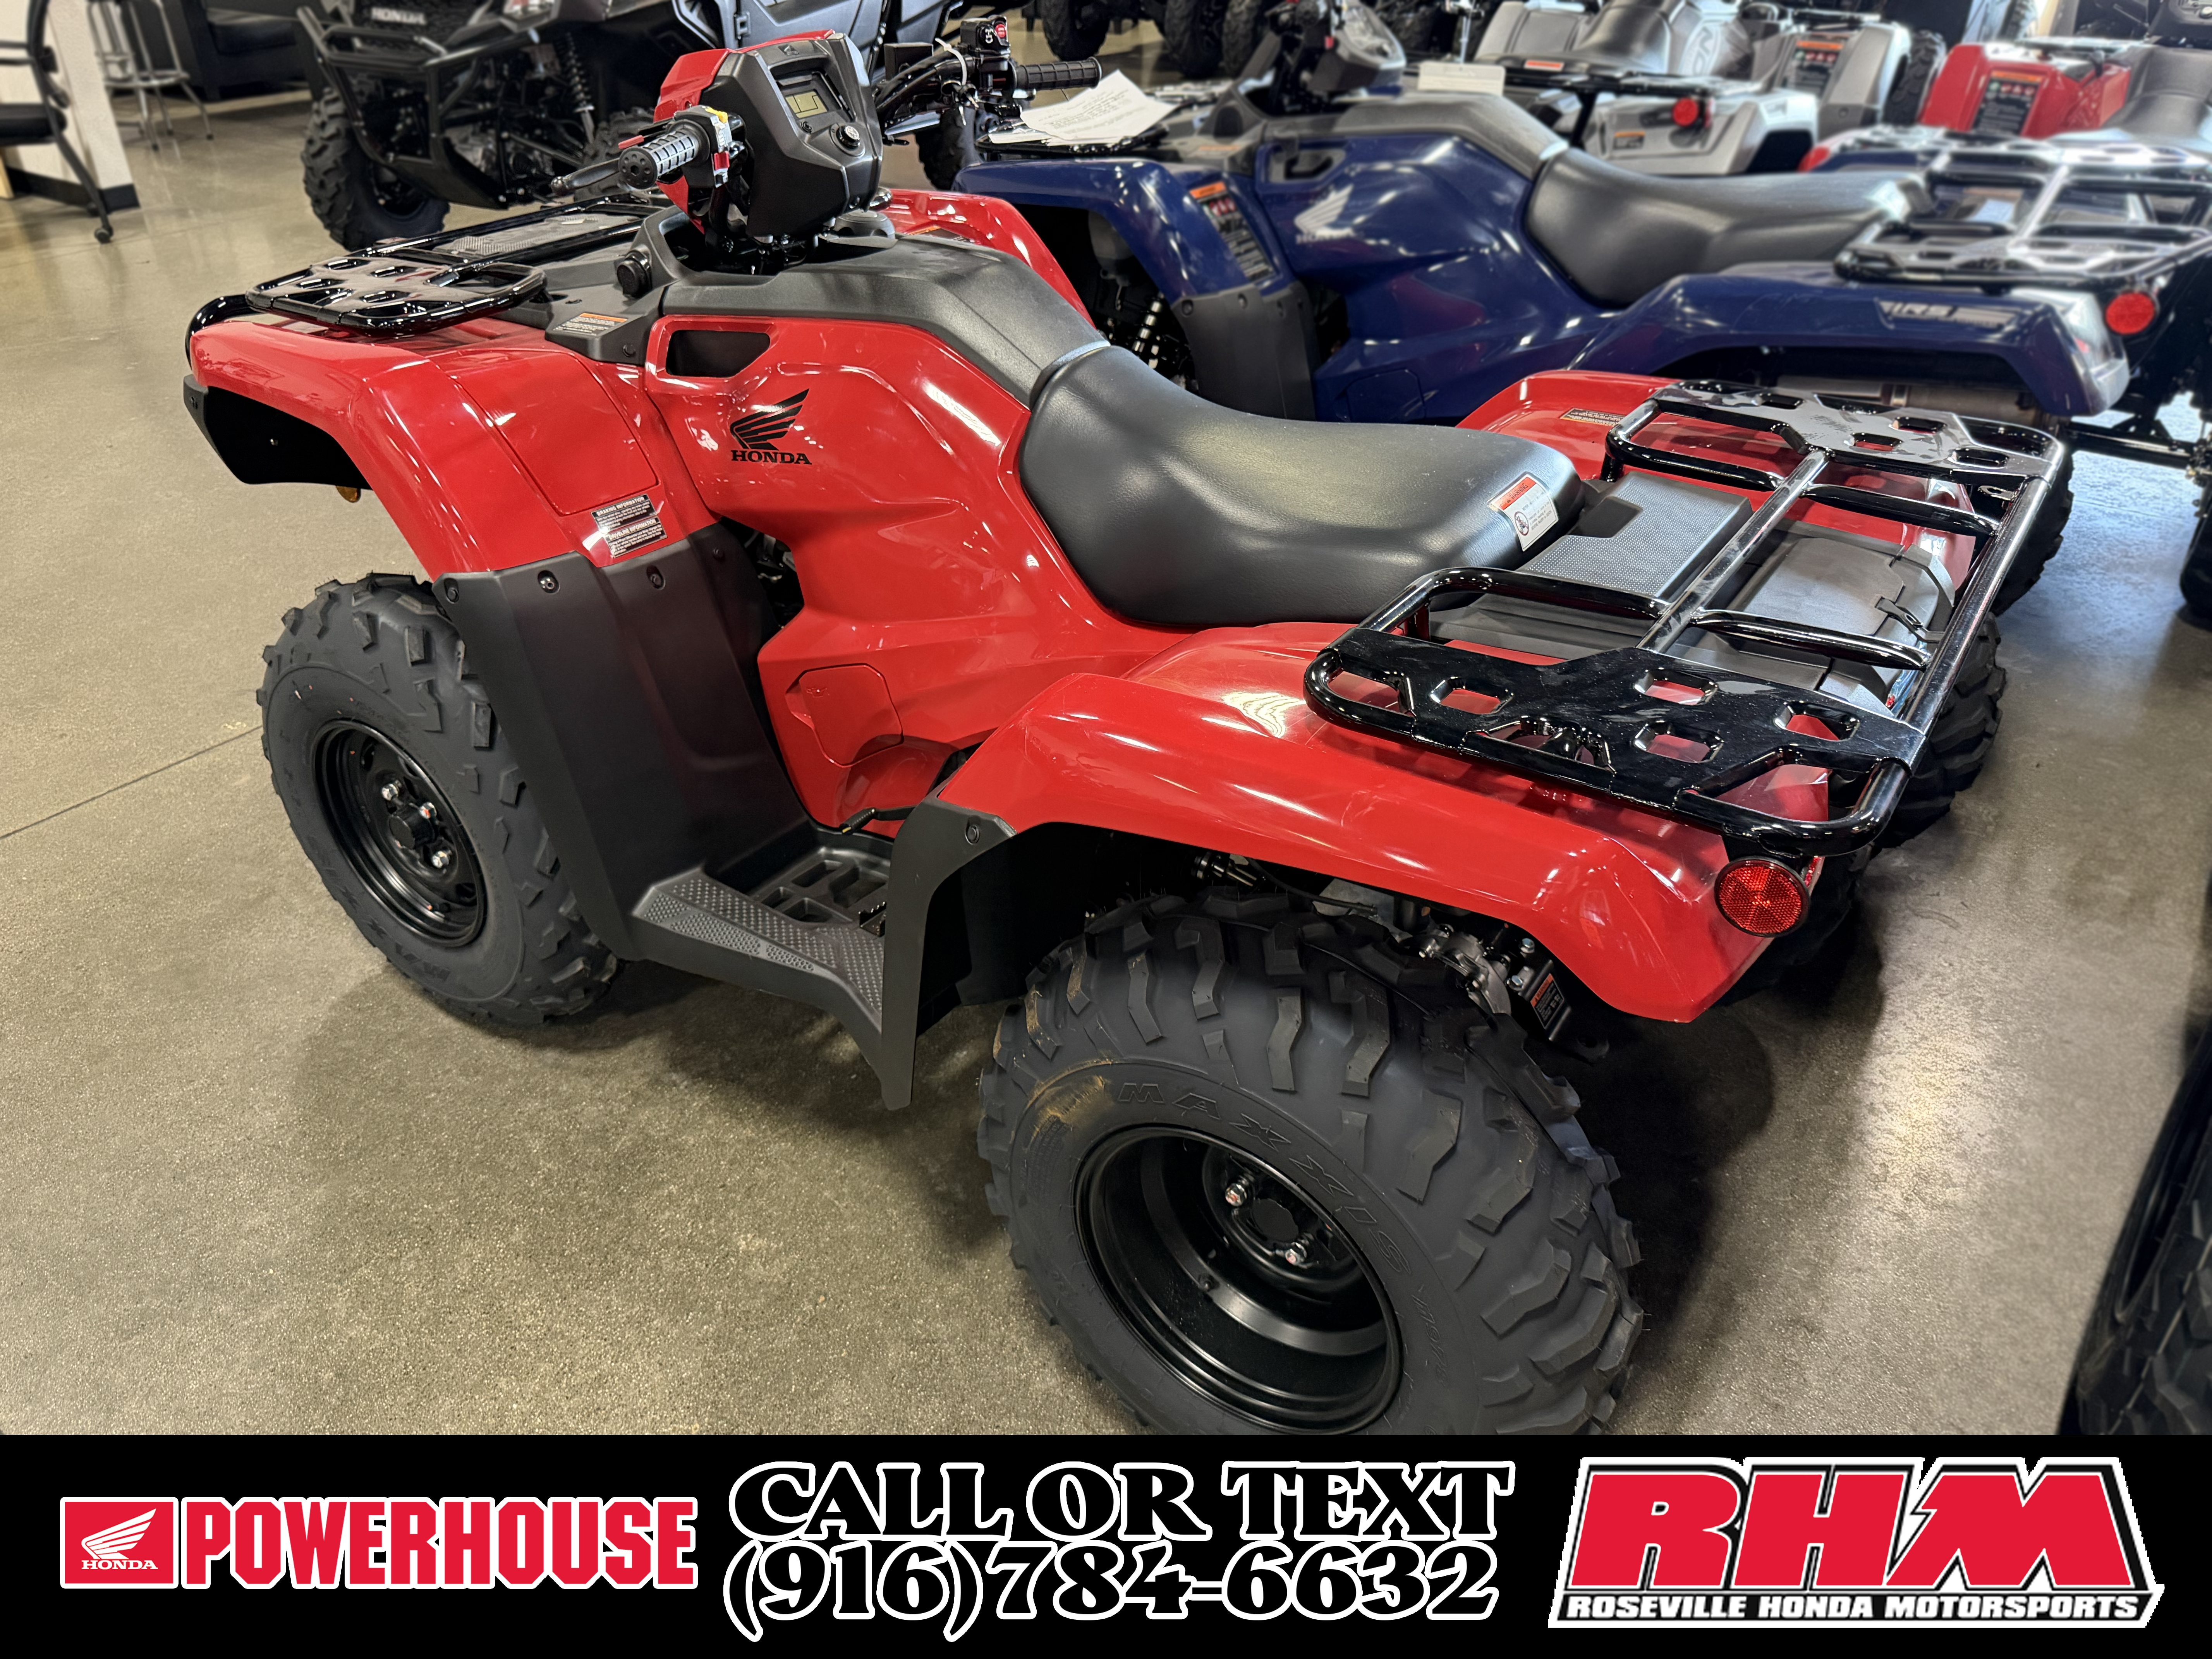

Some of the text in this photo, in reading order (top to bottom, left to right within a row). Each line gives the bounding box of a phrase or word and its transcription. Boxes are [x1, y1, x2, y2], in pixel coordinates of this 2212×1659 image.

[730, 450, 812, 465] HONDA
[1510, 483, 1528, 500] WARNING
[596, 506, 617, 517] BRAKING
[616, 496, 645, 510] INFORMATION
[609, 528, 630, 540] DRIVELINE
[629, 519, 657, 532] INFORMATION
[1117, 1082, 1412, 1276] MAXXIS
